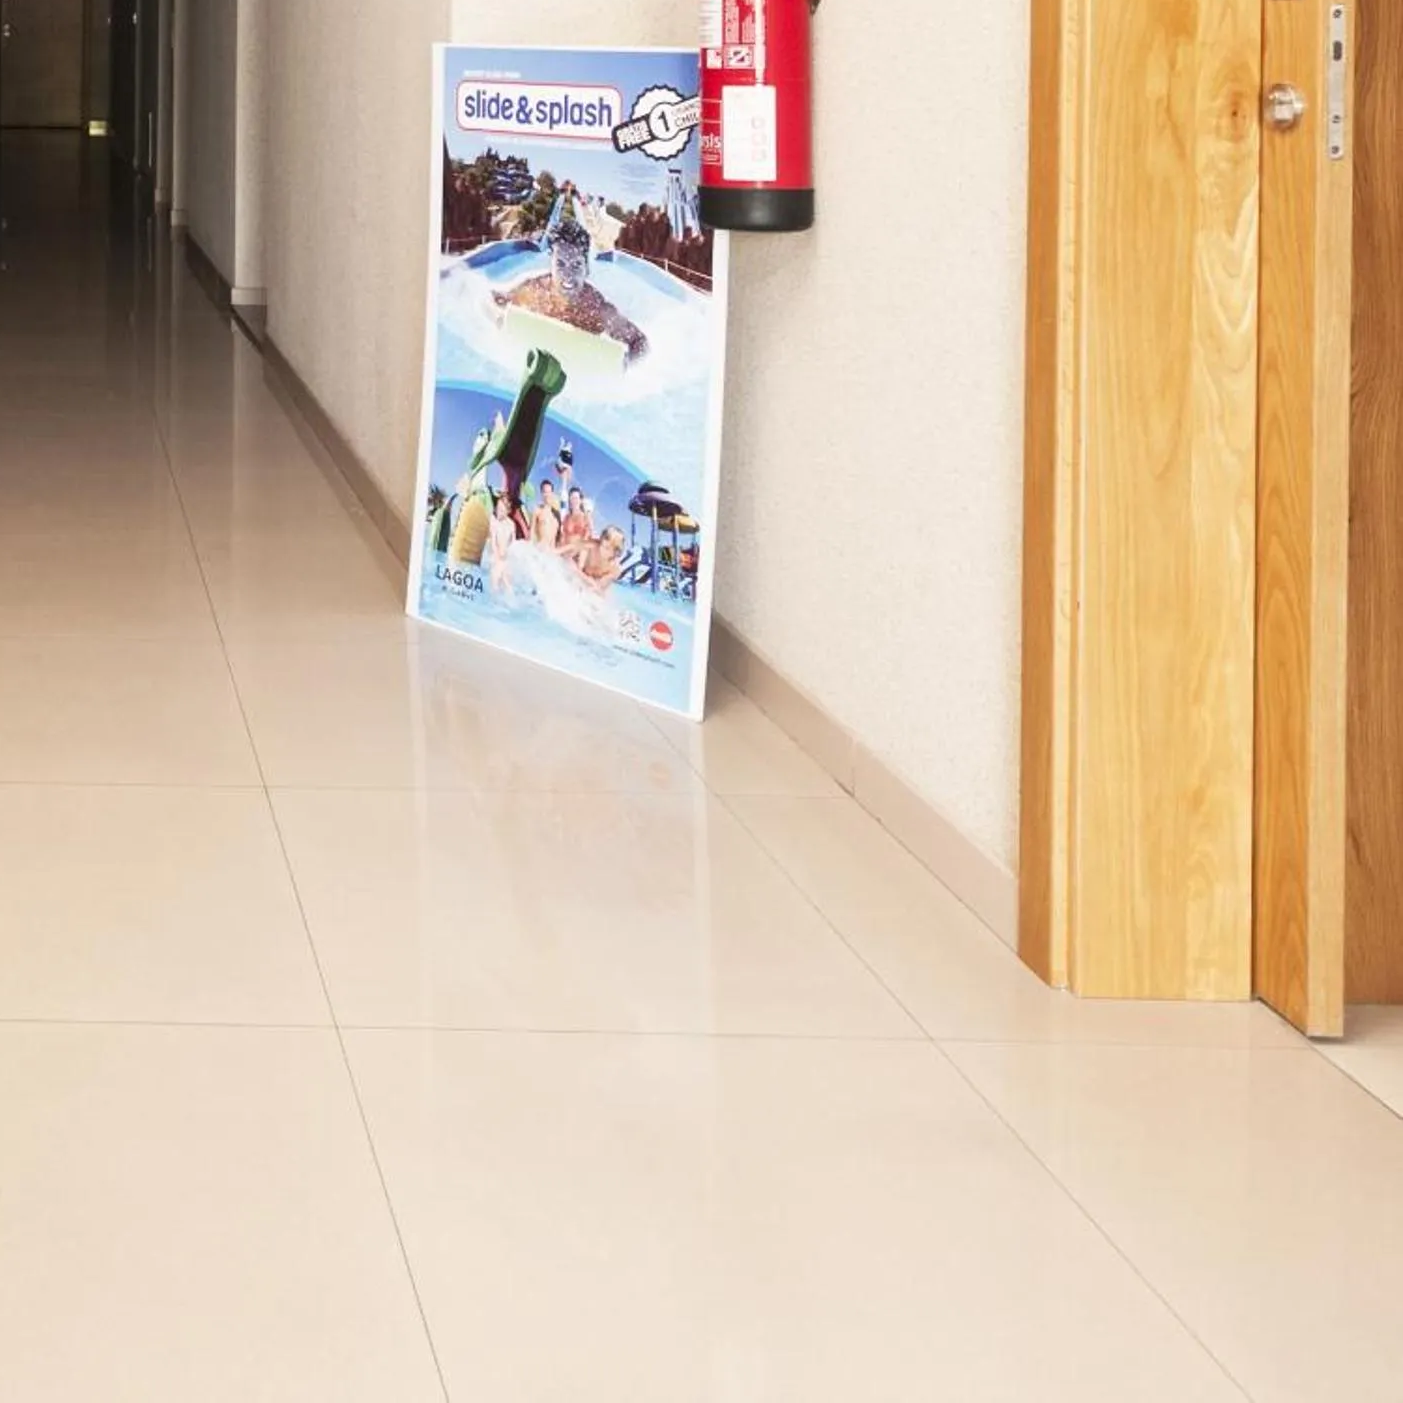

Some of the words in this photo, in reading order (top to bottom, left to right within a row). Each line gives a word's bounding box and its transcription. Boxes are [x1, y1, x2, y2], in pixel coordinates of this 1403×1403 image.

[464, 90, 613, 130] slide&splash
[658, 110, 670, 132] 1
[435, 564, 484, 593] LAGOA
